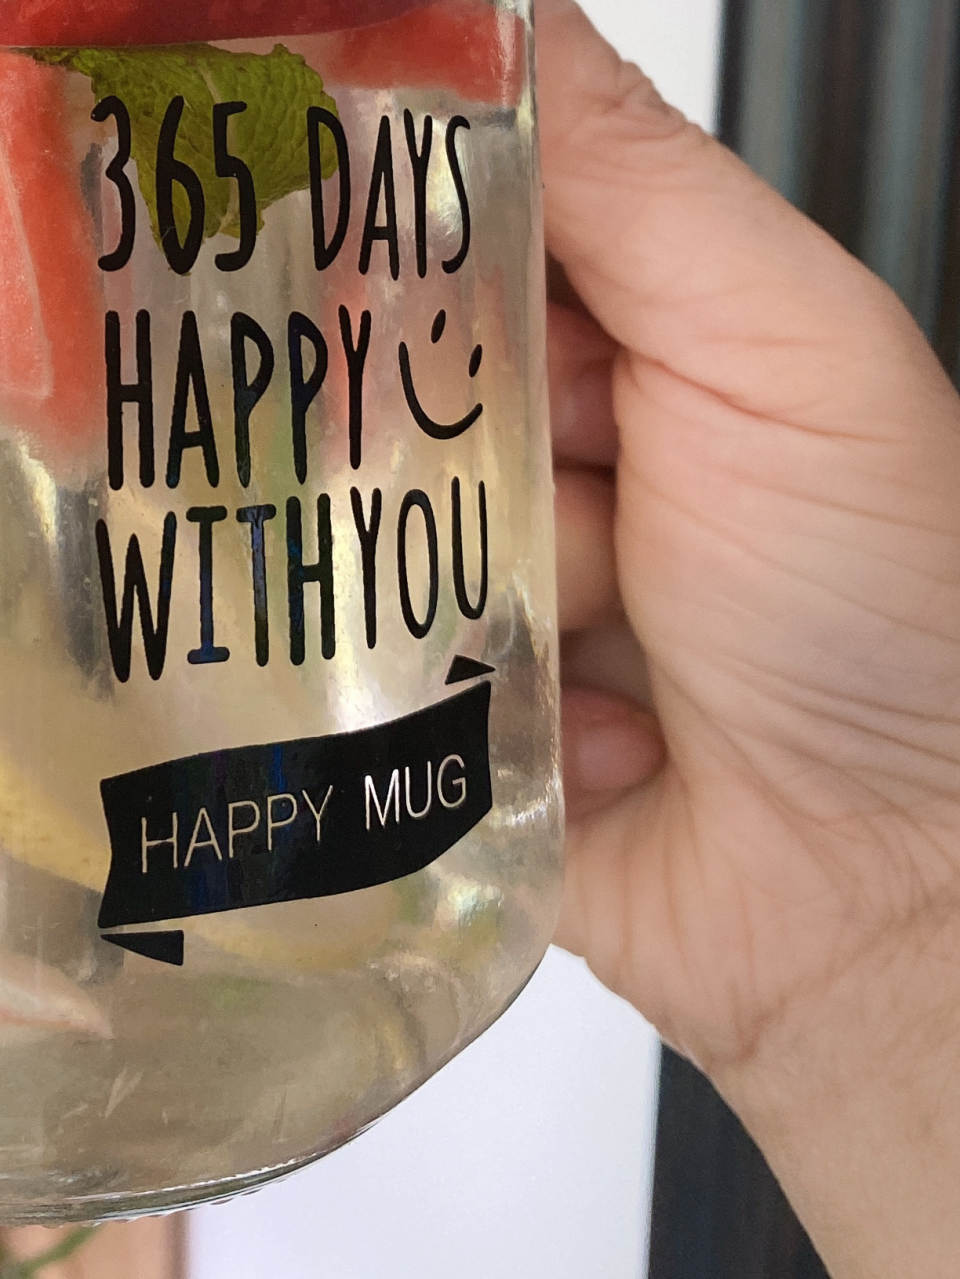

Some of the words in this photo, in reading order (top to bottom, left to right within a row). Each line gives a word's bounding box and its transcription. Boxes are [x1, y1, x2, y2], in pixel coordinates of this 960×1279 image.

[91, 94, 258, 276] 365
[306, 106, 471, 281] DAYS
[104, 304, 372, 491] HAPPY
[140, 784, 334, 874] HAPPY
[363, 753, 468, 831] MUG
